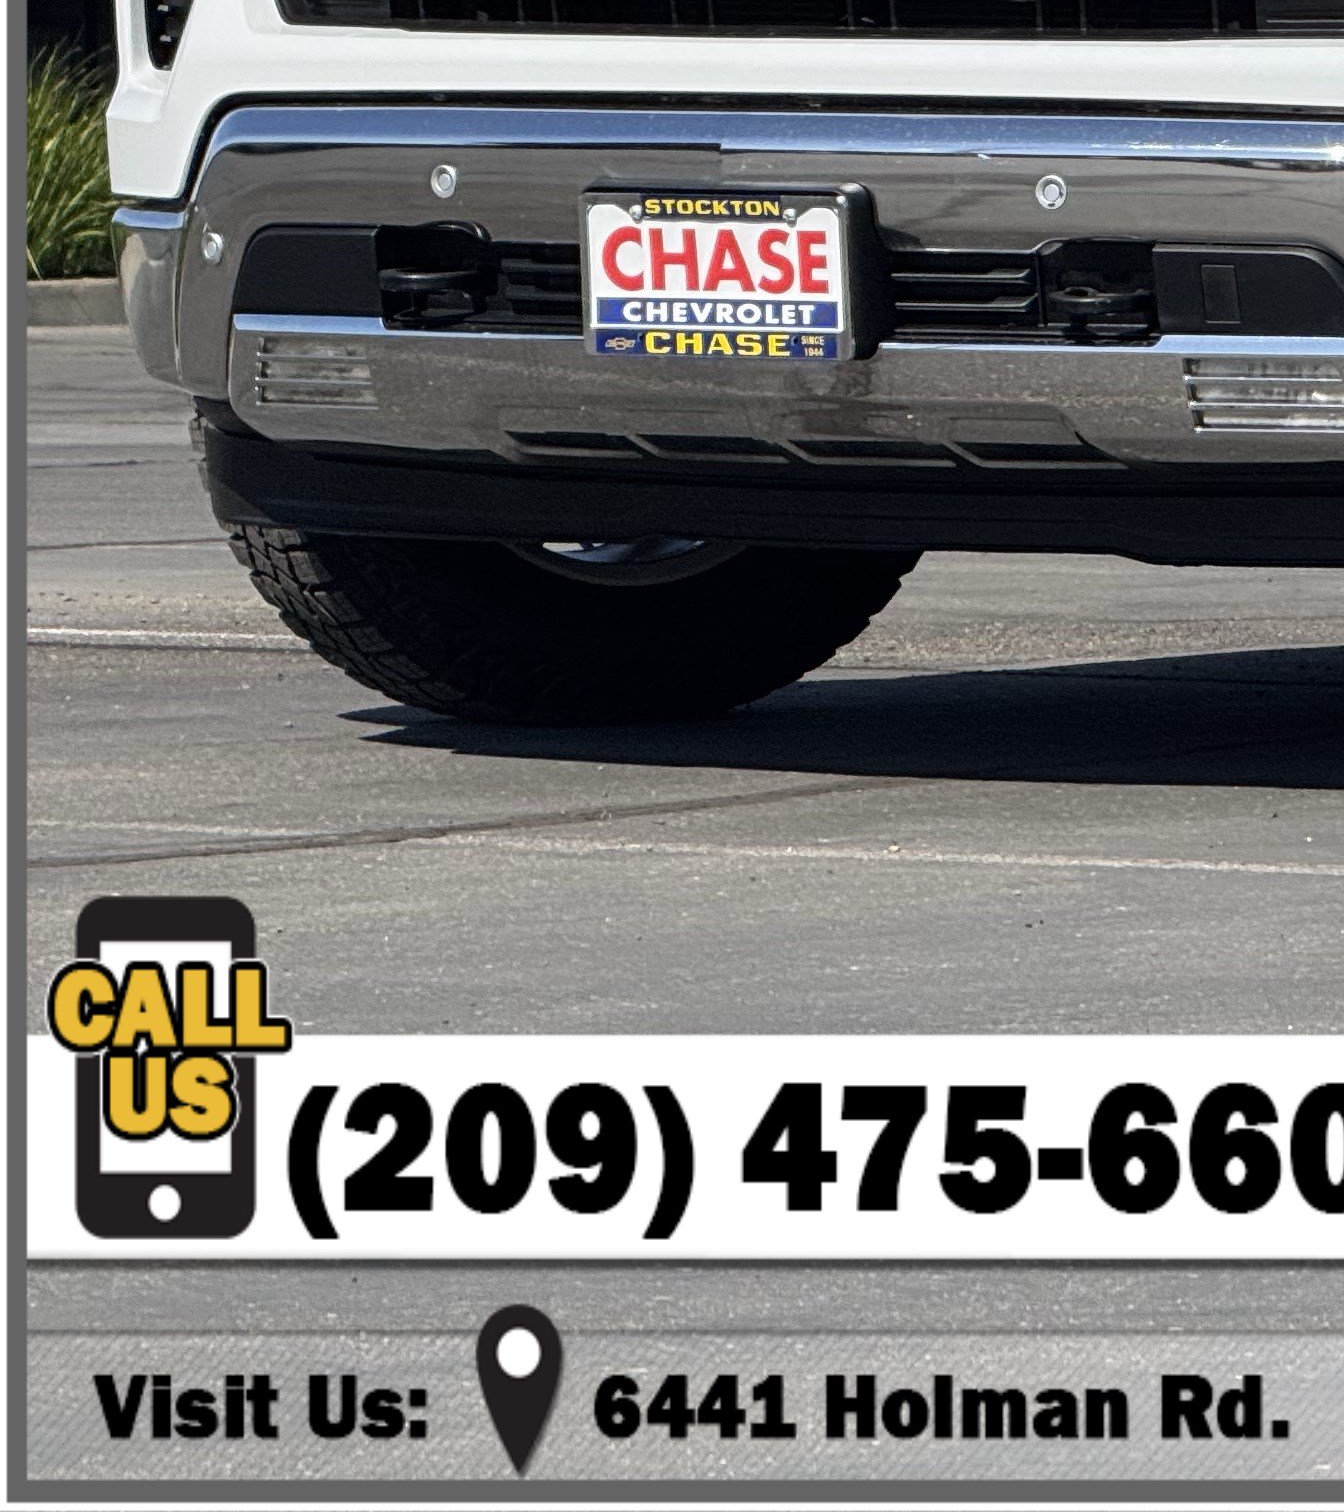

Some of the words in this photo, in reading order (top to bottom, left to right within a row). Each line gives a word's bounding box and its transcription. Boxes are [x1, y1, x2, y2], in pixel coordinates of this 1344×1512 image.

[644, 198, 781, 217] STOCKTON
[602, 225, 830, 295] CHASE
[622, 301, 816, 326] CHEVROLET
[644, 332, 791, 357] CHASE
